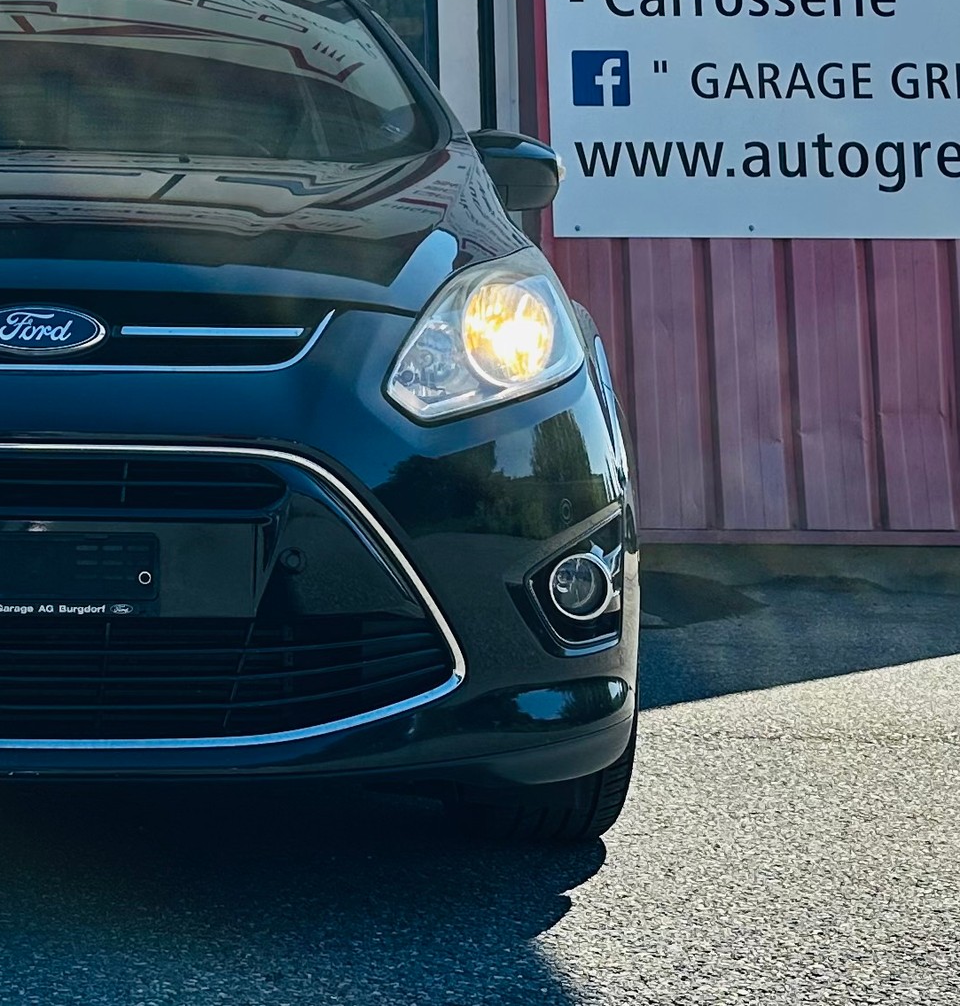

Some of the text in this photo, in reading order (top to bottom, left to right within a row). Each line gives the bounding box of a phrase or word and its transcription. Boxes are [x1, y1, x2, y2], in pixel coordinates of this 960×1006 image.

[690, 62, 874, 100] GARAGE
[890, 62, 960, 100] GR
[574, 132, 960, 193] www.autogre
[38, 604, 54, 614] AG
[58, 604, 106, 616] Burgdorf
